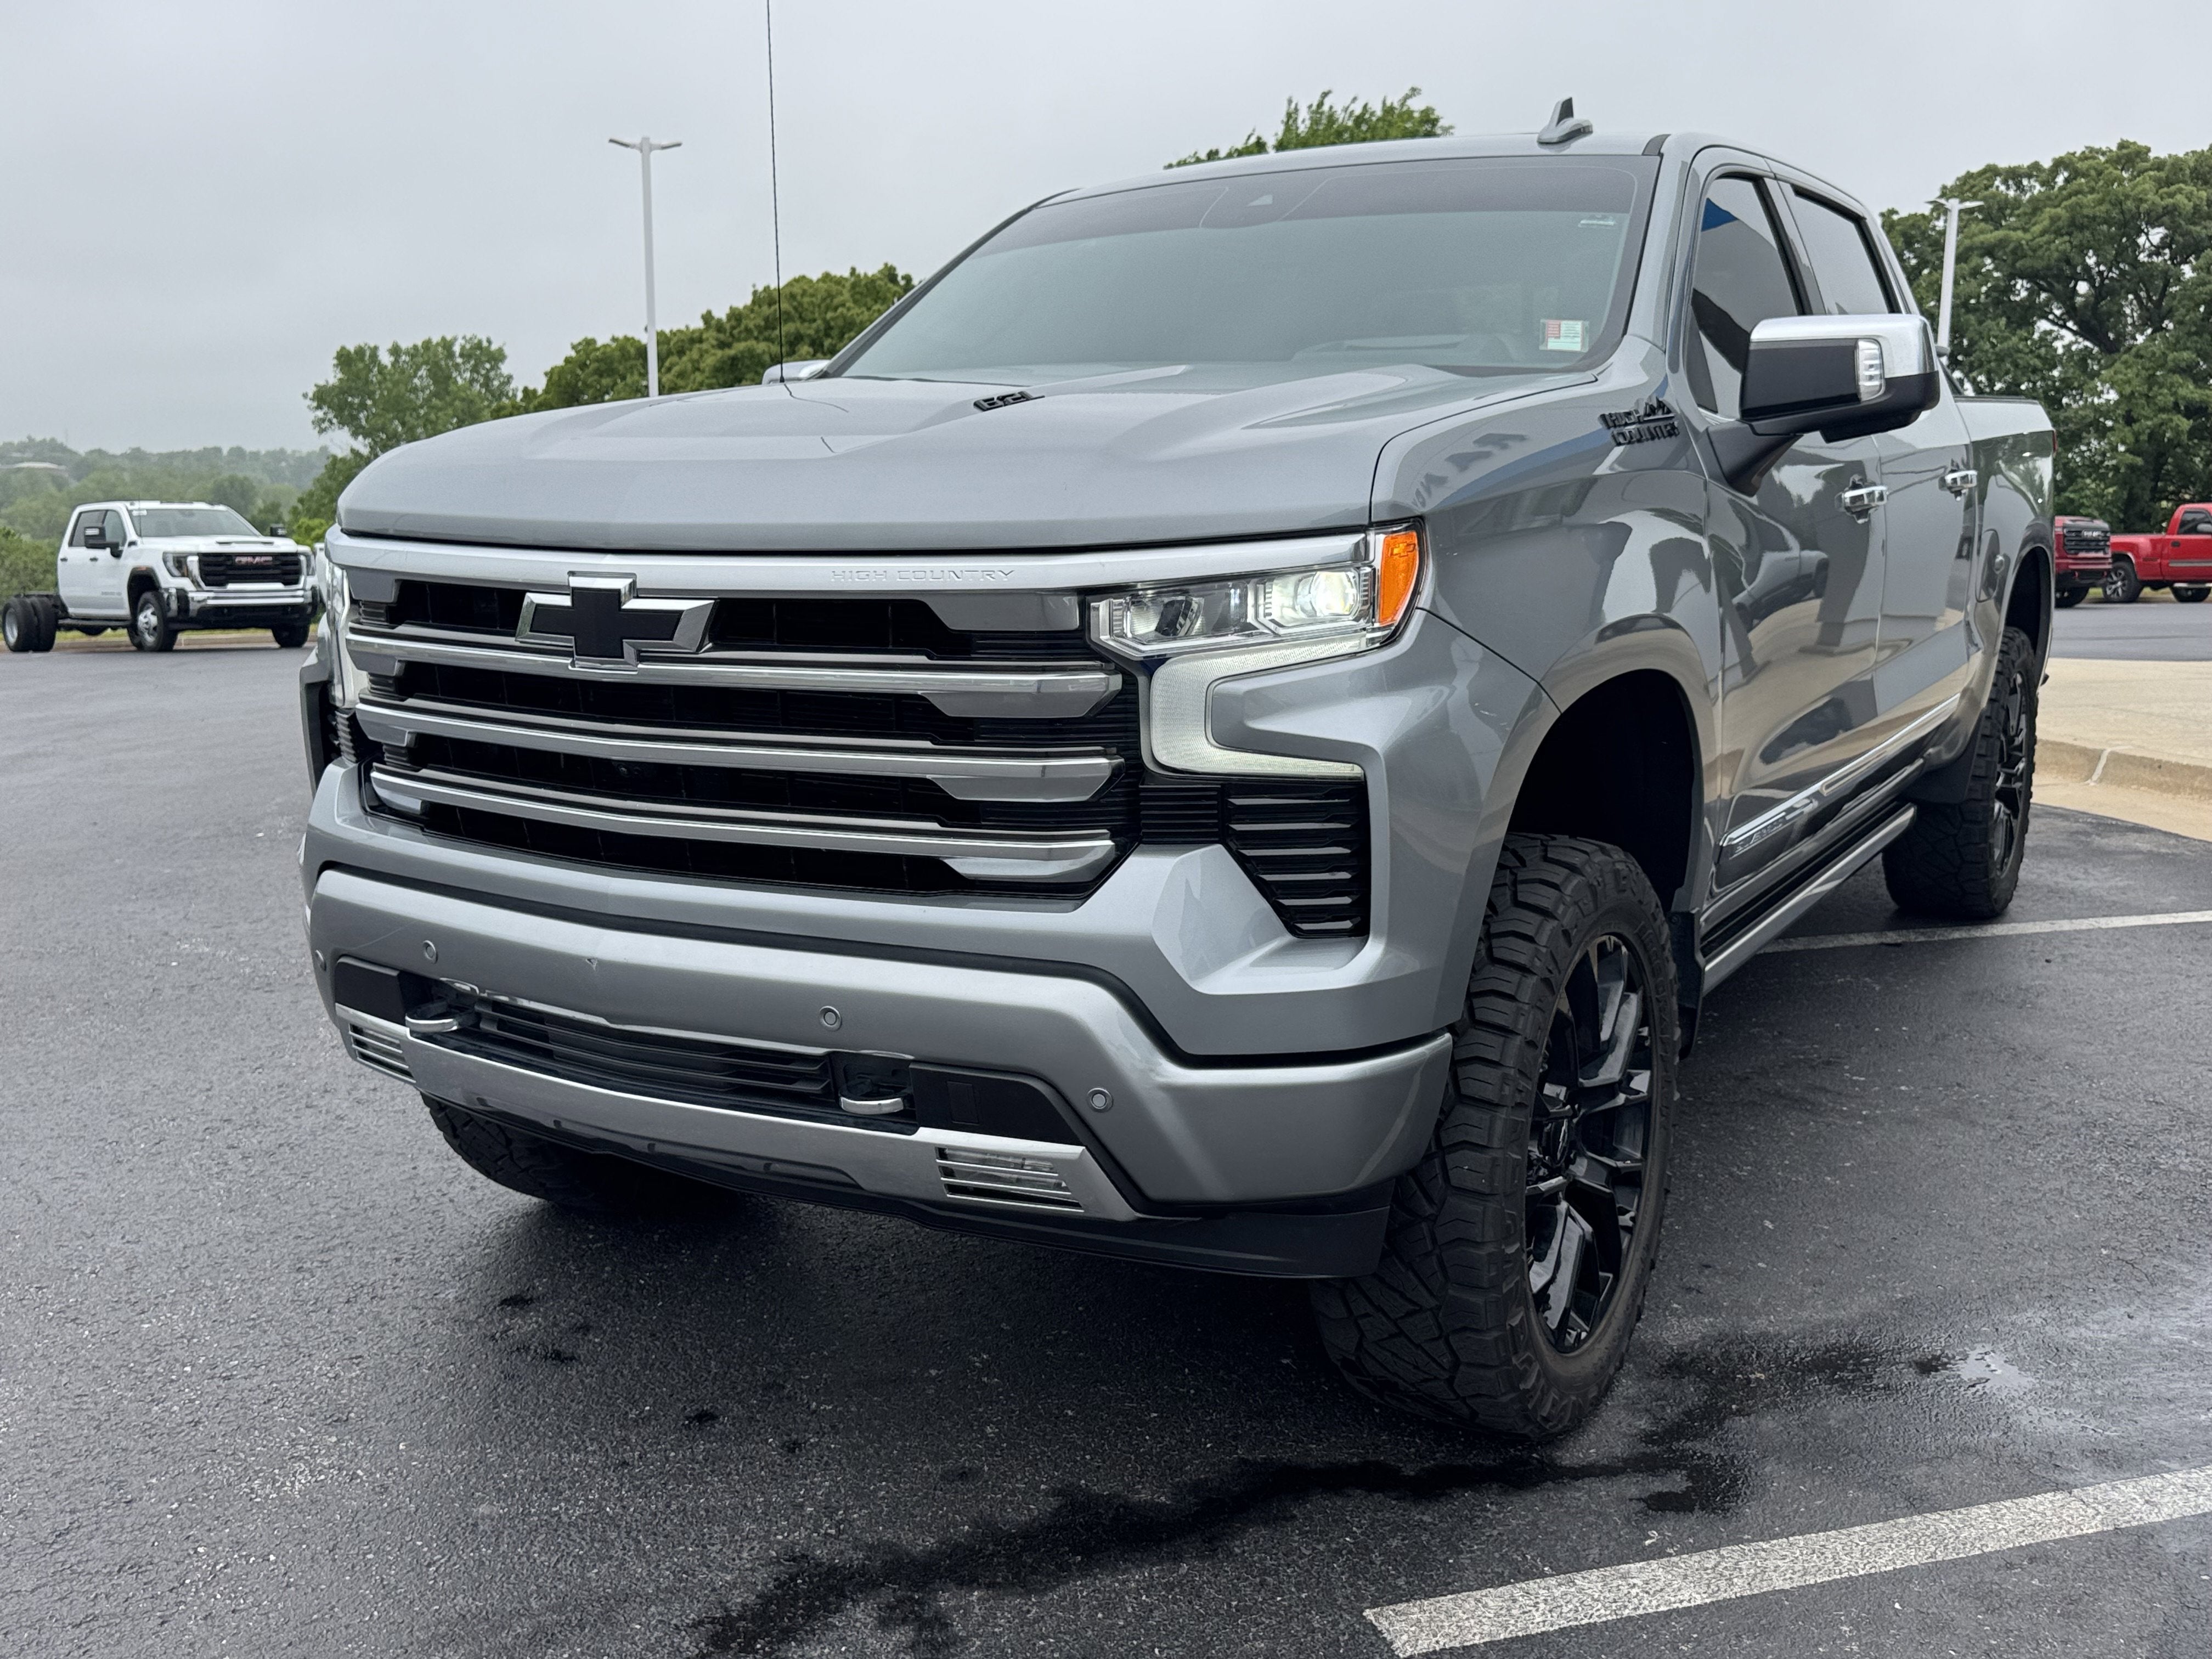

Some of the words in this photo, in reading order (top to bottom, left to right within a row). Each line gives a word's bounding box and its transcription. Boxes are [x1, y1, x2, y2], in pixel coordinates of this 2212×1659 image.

[235, 556, 273, 565] GMC
[831, 570, 887, 581] HIGH
[896, 569, 1015, 581] COUNTRY
